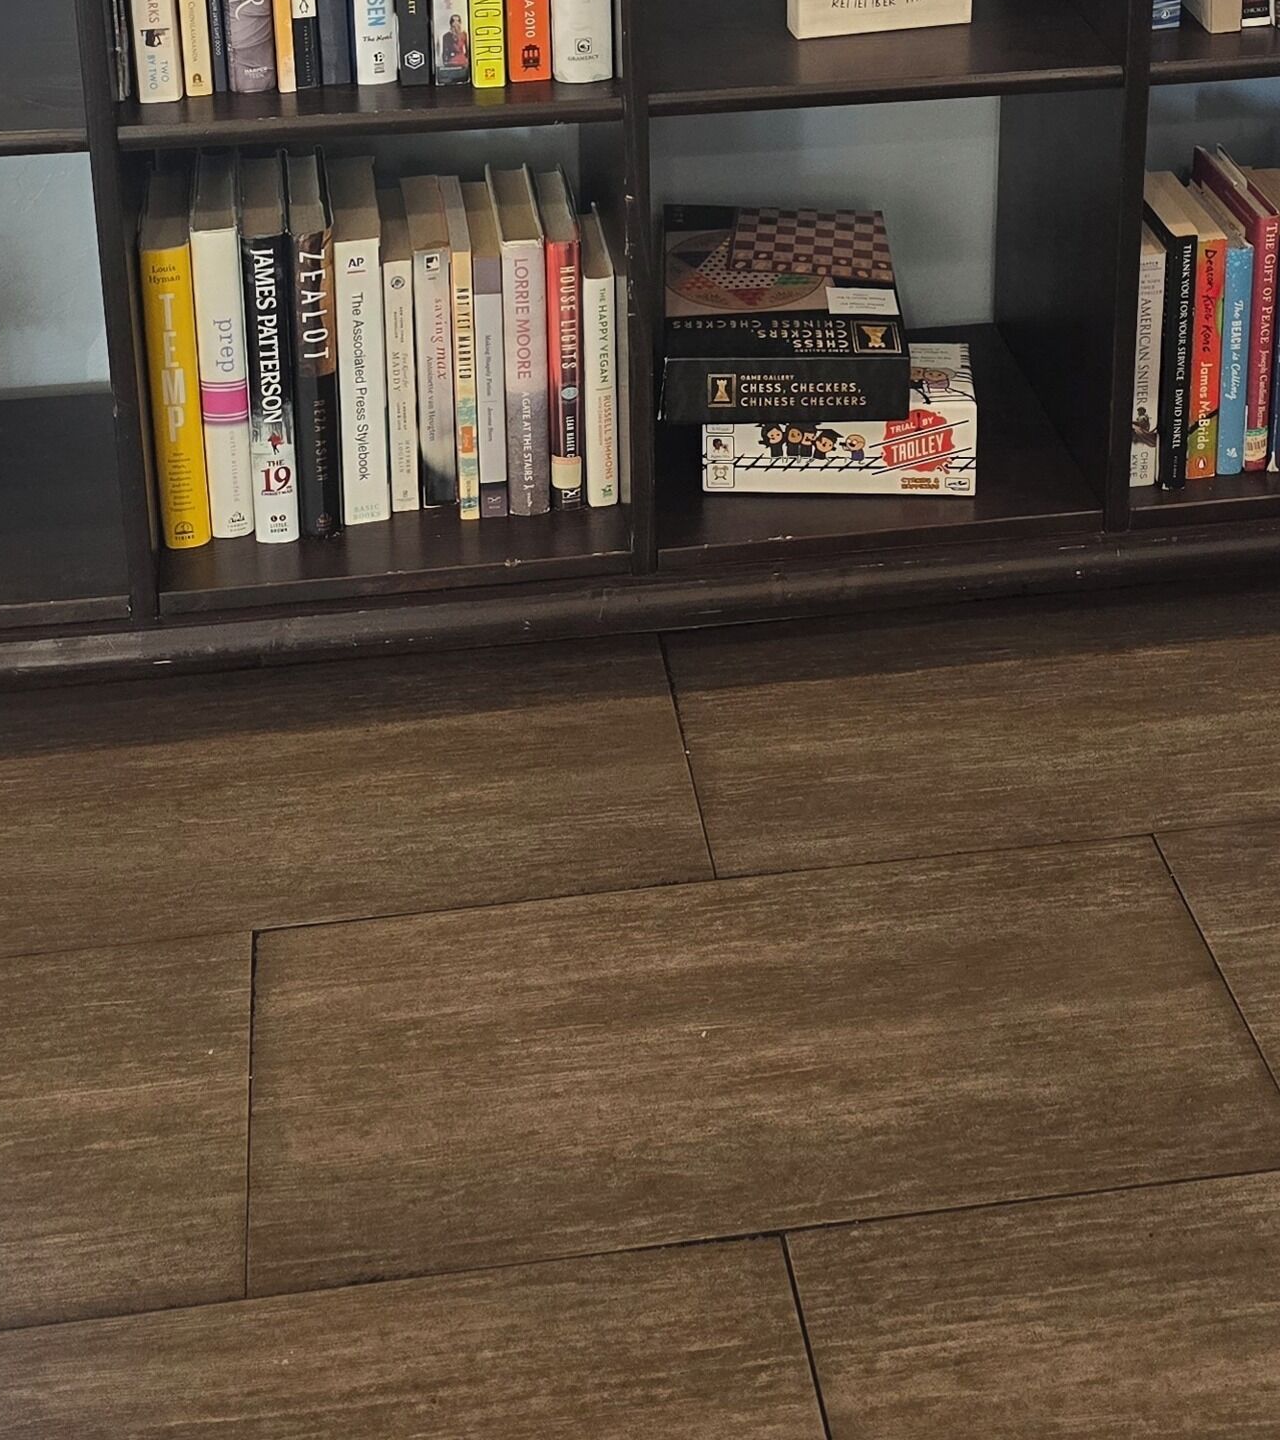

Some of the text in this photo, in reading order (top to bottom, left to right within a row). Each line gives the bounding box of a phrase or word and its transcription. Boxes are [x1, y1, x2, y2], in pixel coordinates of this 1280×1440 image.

[524, 12, 536, 38] 2010
[147, 55, 158, 90] BY TWO
[160, 61, 169, 82] TWO
[149, 275, 181, 285] Hyman
[152, 265, 176, 273] Louis
[348, 258, 365, 268] AP
[1260, 223, 1278, 344] THE GIFT OF PEACE
[299, 249, 329, 359] ZEALOT
[514, 259, 532, 379] LORRIE MOORE
[560, 266, 577, 369] HOUSE LIGHTS
[1175, 243, 1192, 381] THANK YOU FOR YOUR SERVICE
[1234, 300, 1244, 319] The
[249, 248, 283, 424] JAMES PATTERSON
[430, 298, 448, 380] saving max
[456, 288, 472, 379] NOT YET MARRIED
[598, 288, 609, 383] THE HAPPY VEGAN
[673, 320, 846, 329] CHINESE CHECKERS
[1138, 298, 1152, 358] AMERICAN
[1231, 321, 1242, 350] BEACH
[213, 318, 235, 372] prep
[158, 293, 187, 443] TEMP
[351, 292, 370, 481] The Associated Press Stylebook
[391, 351, 402, 392] MADDY
[1136, 365, 1149, 406] SNIPER
[1225, 363, 1241, 401] Calling
[740, 382, 862, 394] CHESS, CHECKERS,
[740, 395, 868, 407] CHINESE CHECKERS
[1174, 389, 1184, 417] DAVID
[1197, 362, 1213, 450] James McBride
[603, 395, 613, 480] RUSSELL SIMMONS
[889, 416, 935, 434] TRIAL BY
[1172, 418, 1183, 449] FINKEL
[891, 434, 945, 464] TROLLEY
[1138, 451, 1149, 480] CHRIS
